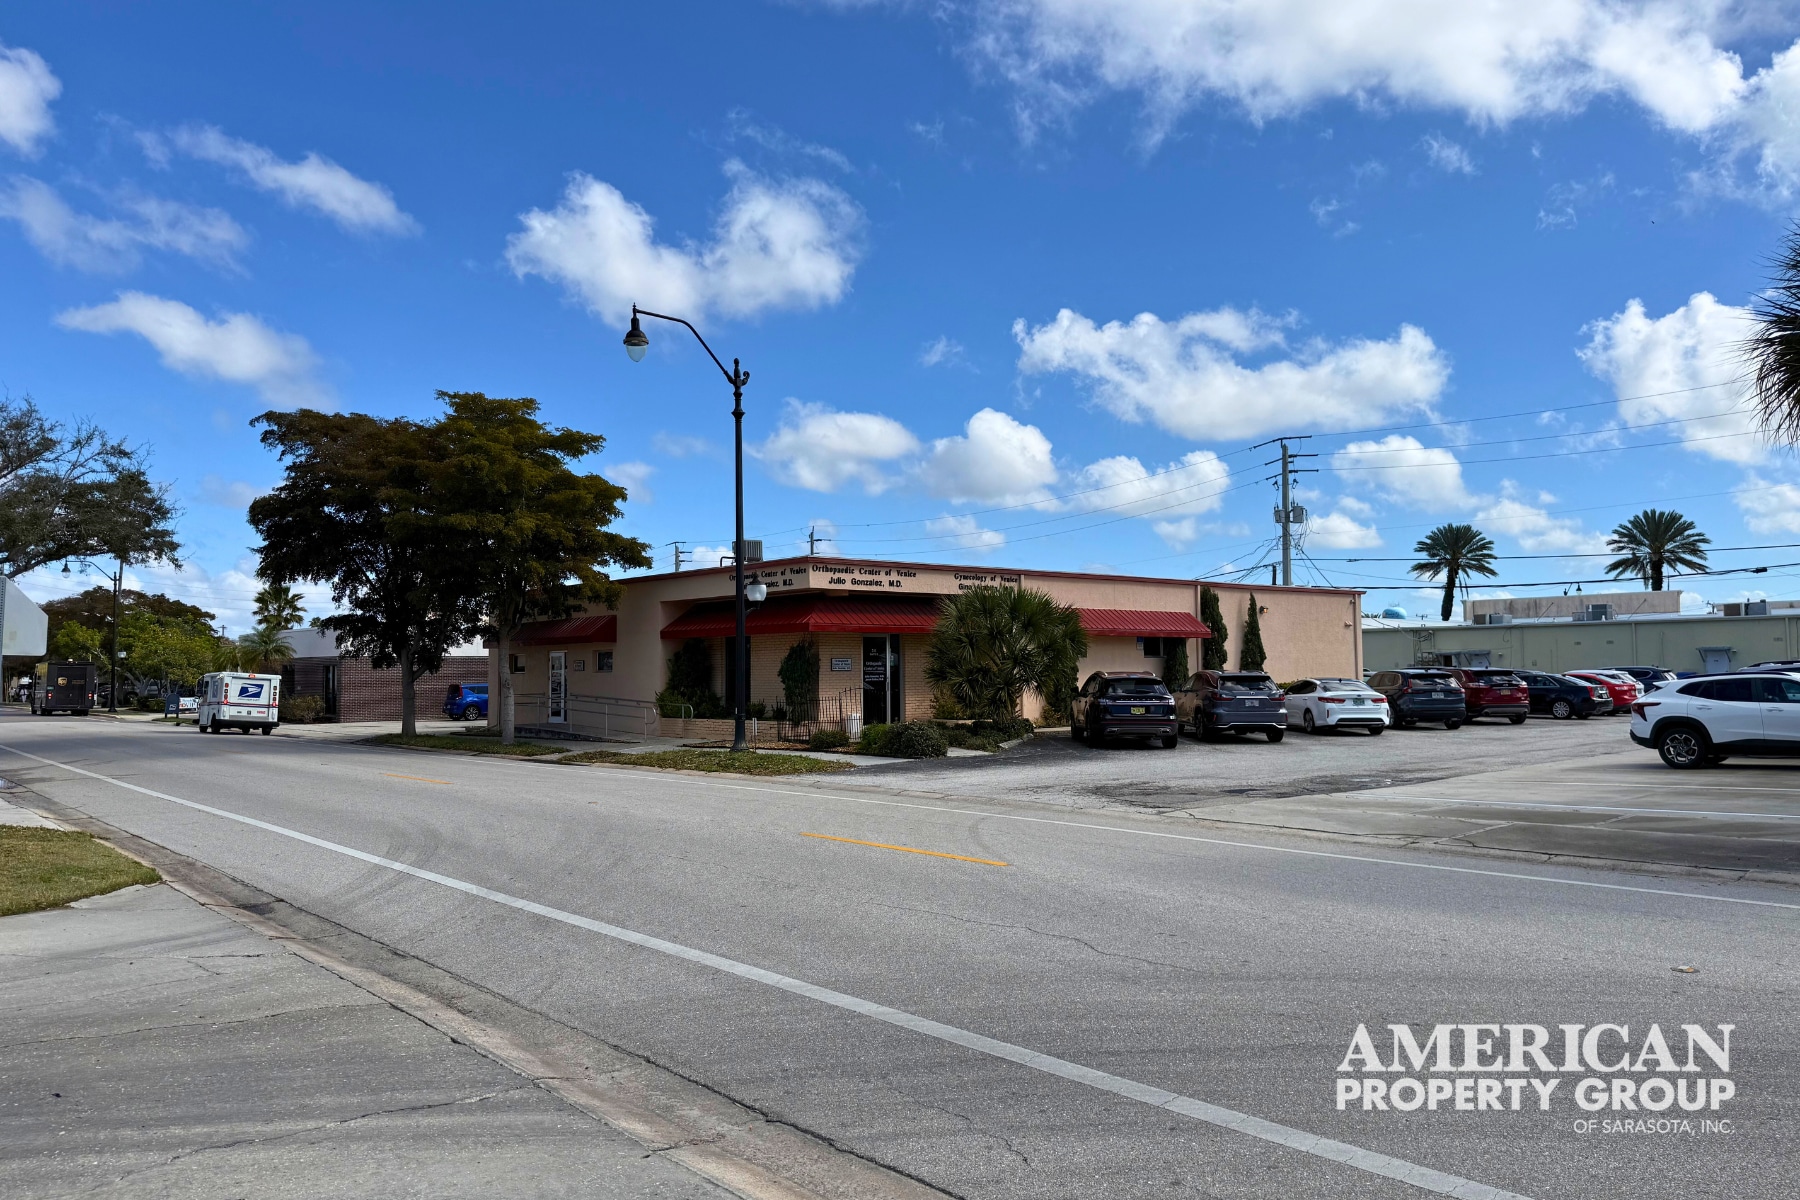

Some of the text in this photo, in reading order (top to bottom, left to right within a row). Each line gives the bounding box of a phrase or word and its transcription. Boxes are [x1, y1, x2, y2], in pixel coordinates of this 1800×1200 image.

[761, 570, 778, 578] Center
[781, 568, 787, 576] of
[789, 566, 807, 575] Venice
[812, 564, 917, 578] Orthopaedic Center of Venice
[783, 578, 794, 587] M.D.
[828, 576, 903, 588] Julio Gonzalez, M.D.
[954, 573, 987, 582] Gynecology
[1000, 575, 1018, 583] Venice
